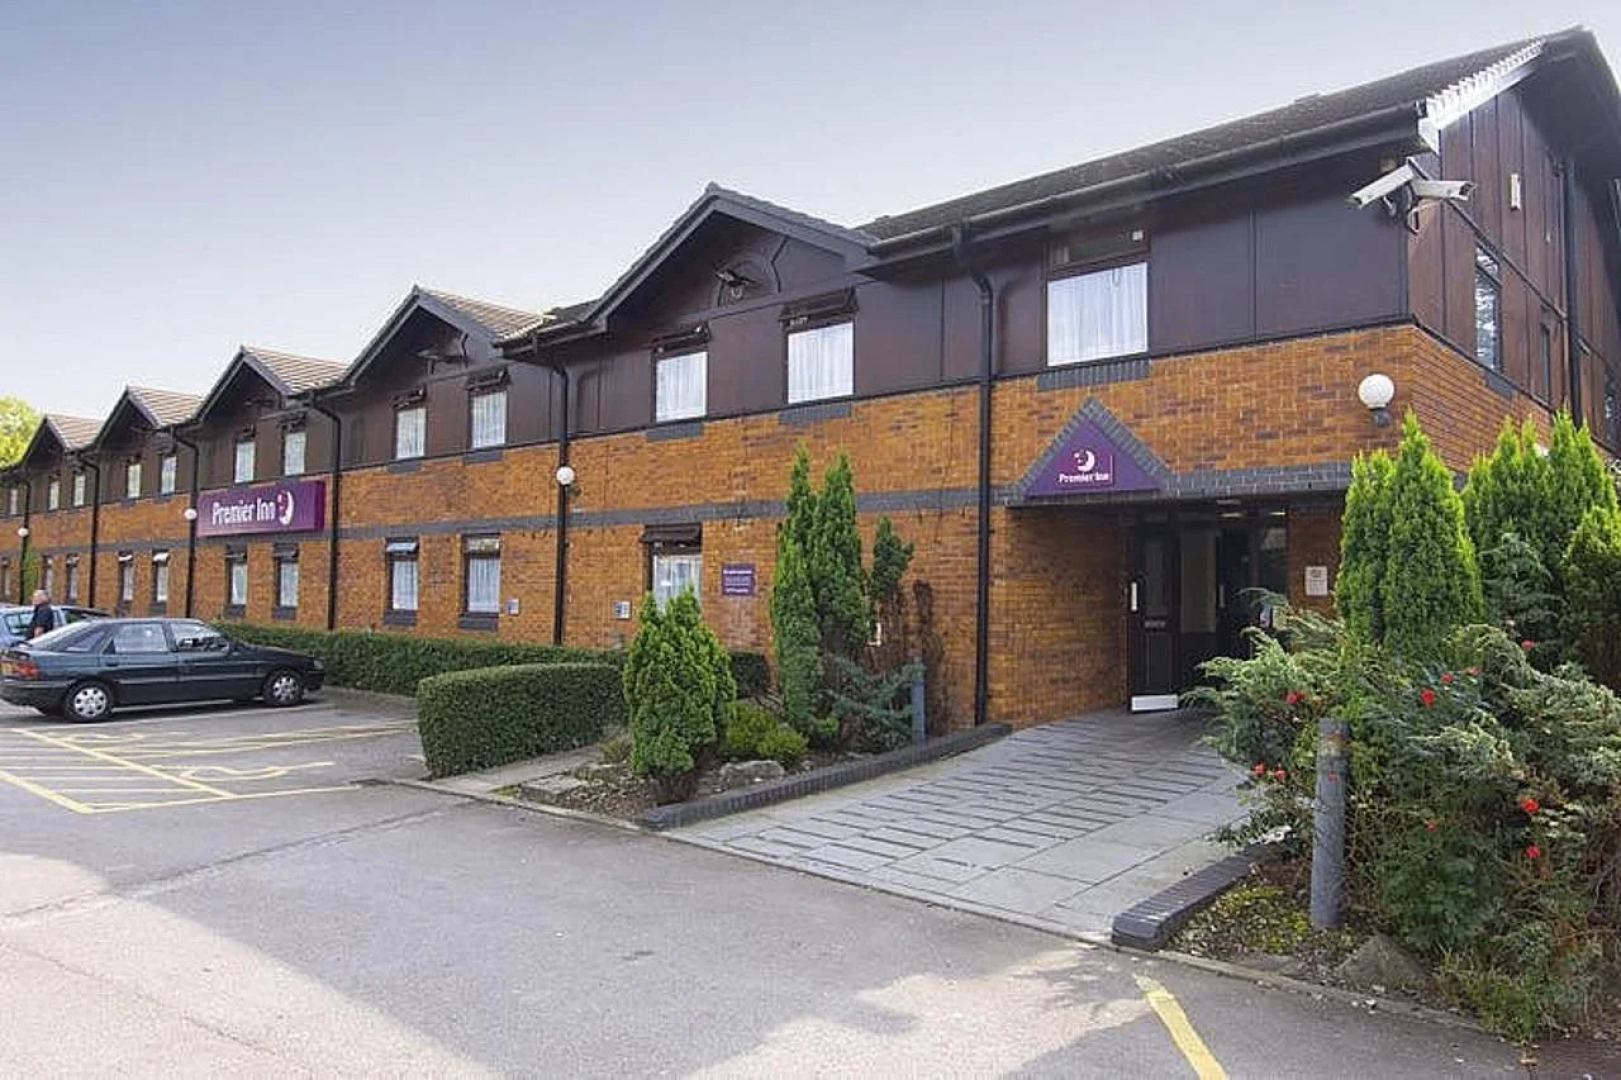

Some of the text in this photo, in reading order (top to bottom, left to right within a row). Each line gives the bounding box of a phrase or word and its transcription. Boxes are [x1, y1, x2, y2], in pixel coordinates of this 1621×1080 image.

[1059, 473, 1093, 483] Premier
[212, 497, 276, 525] Premier Inn
